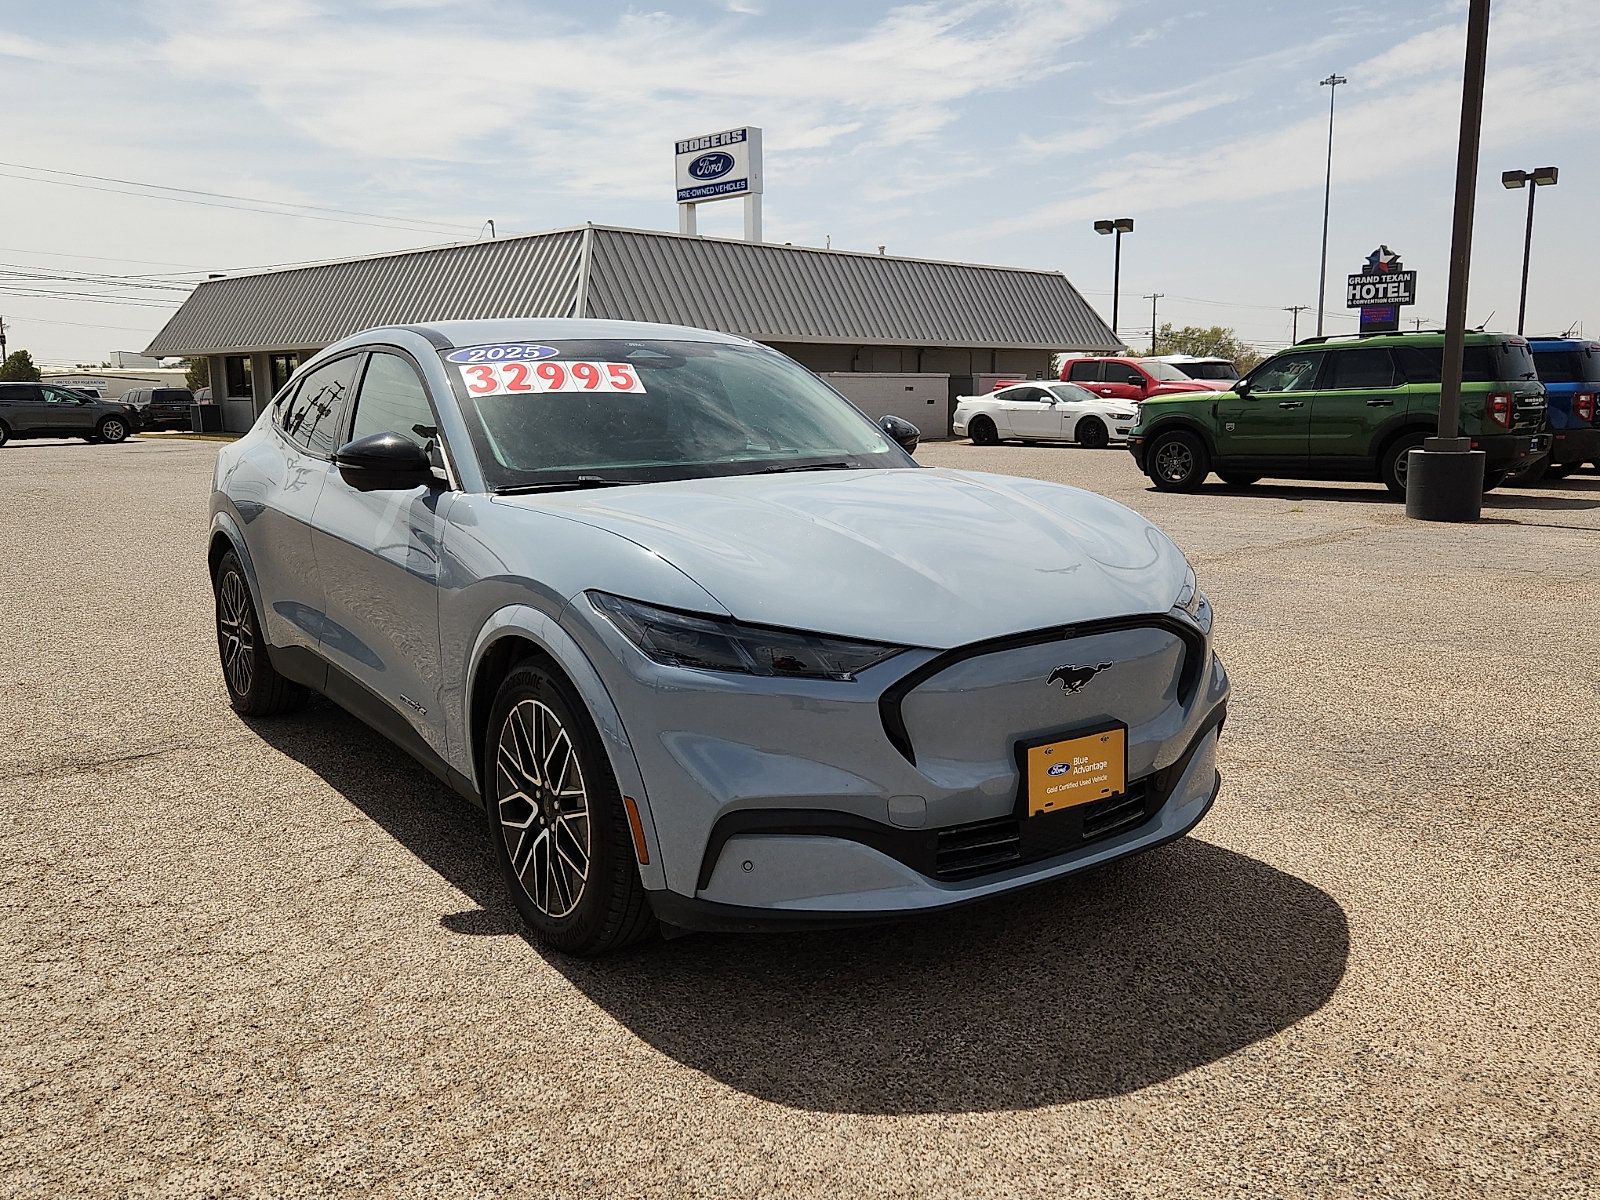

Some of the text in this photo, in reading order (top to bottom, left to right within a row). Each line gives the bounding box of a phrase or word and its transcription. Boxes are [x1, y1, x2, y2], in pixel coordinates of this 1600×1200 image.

[678, 130, 743, 154] ROGERS
[696, 156, 723, 176] Ford
[678, 181, 746, 199] PRE-OWNED VEHICLES
[1348, 274, 1410, 284] GRAND TEXAN
[1348, 282, 1410, 300] HOTEL
[468, 347, 540, 362] 2025
[466, 362, 638, 393] 32995
[1073, 756, 1088, 766] Blue
[1073, 760, 1108, 775] Advantage
[1058, 781, 1078, 791] Certified
[1080, 778, 1092, 786] Used
[1092, 774, 1108, 784] Vehicle
